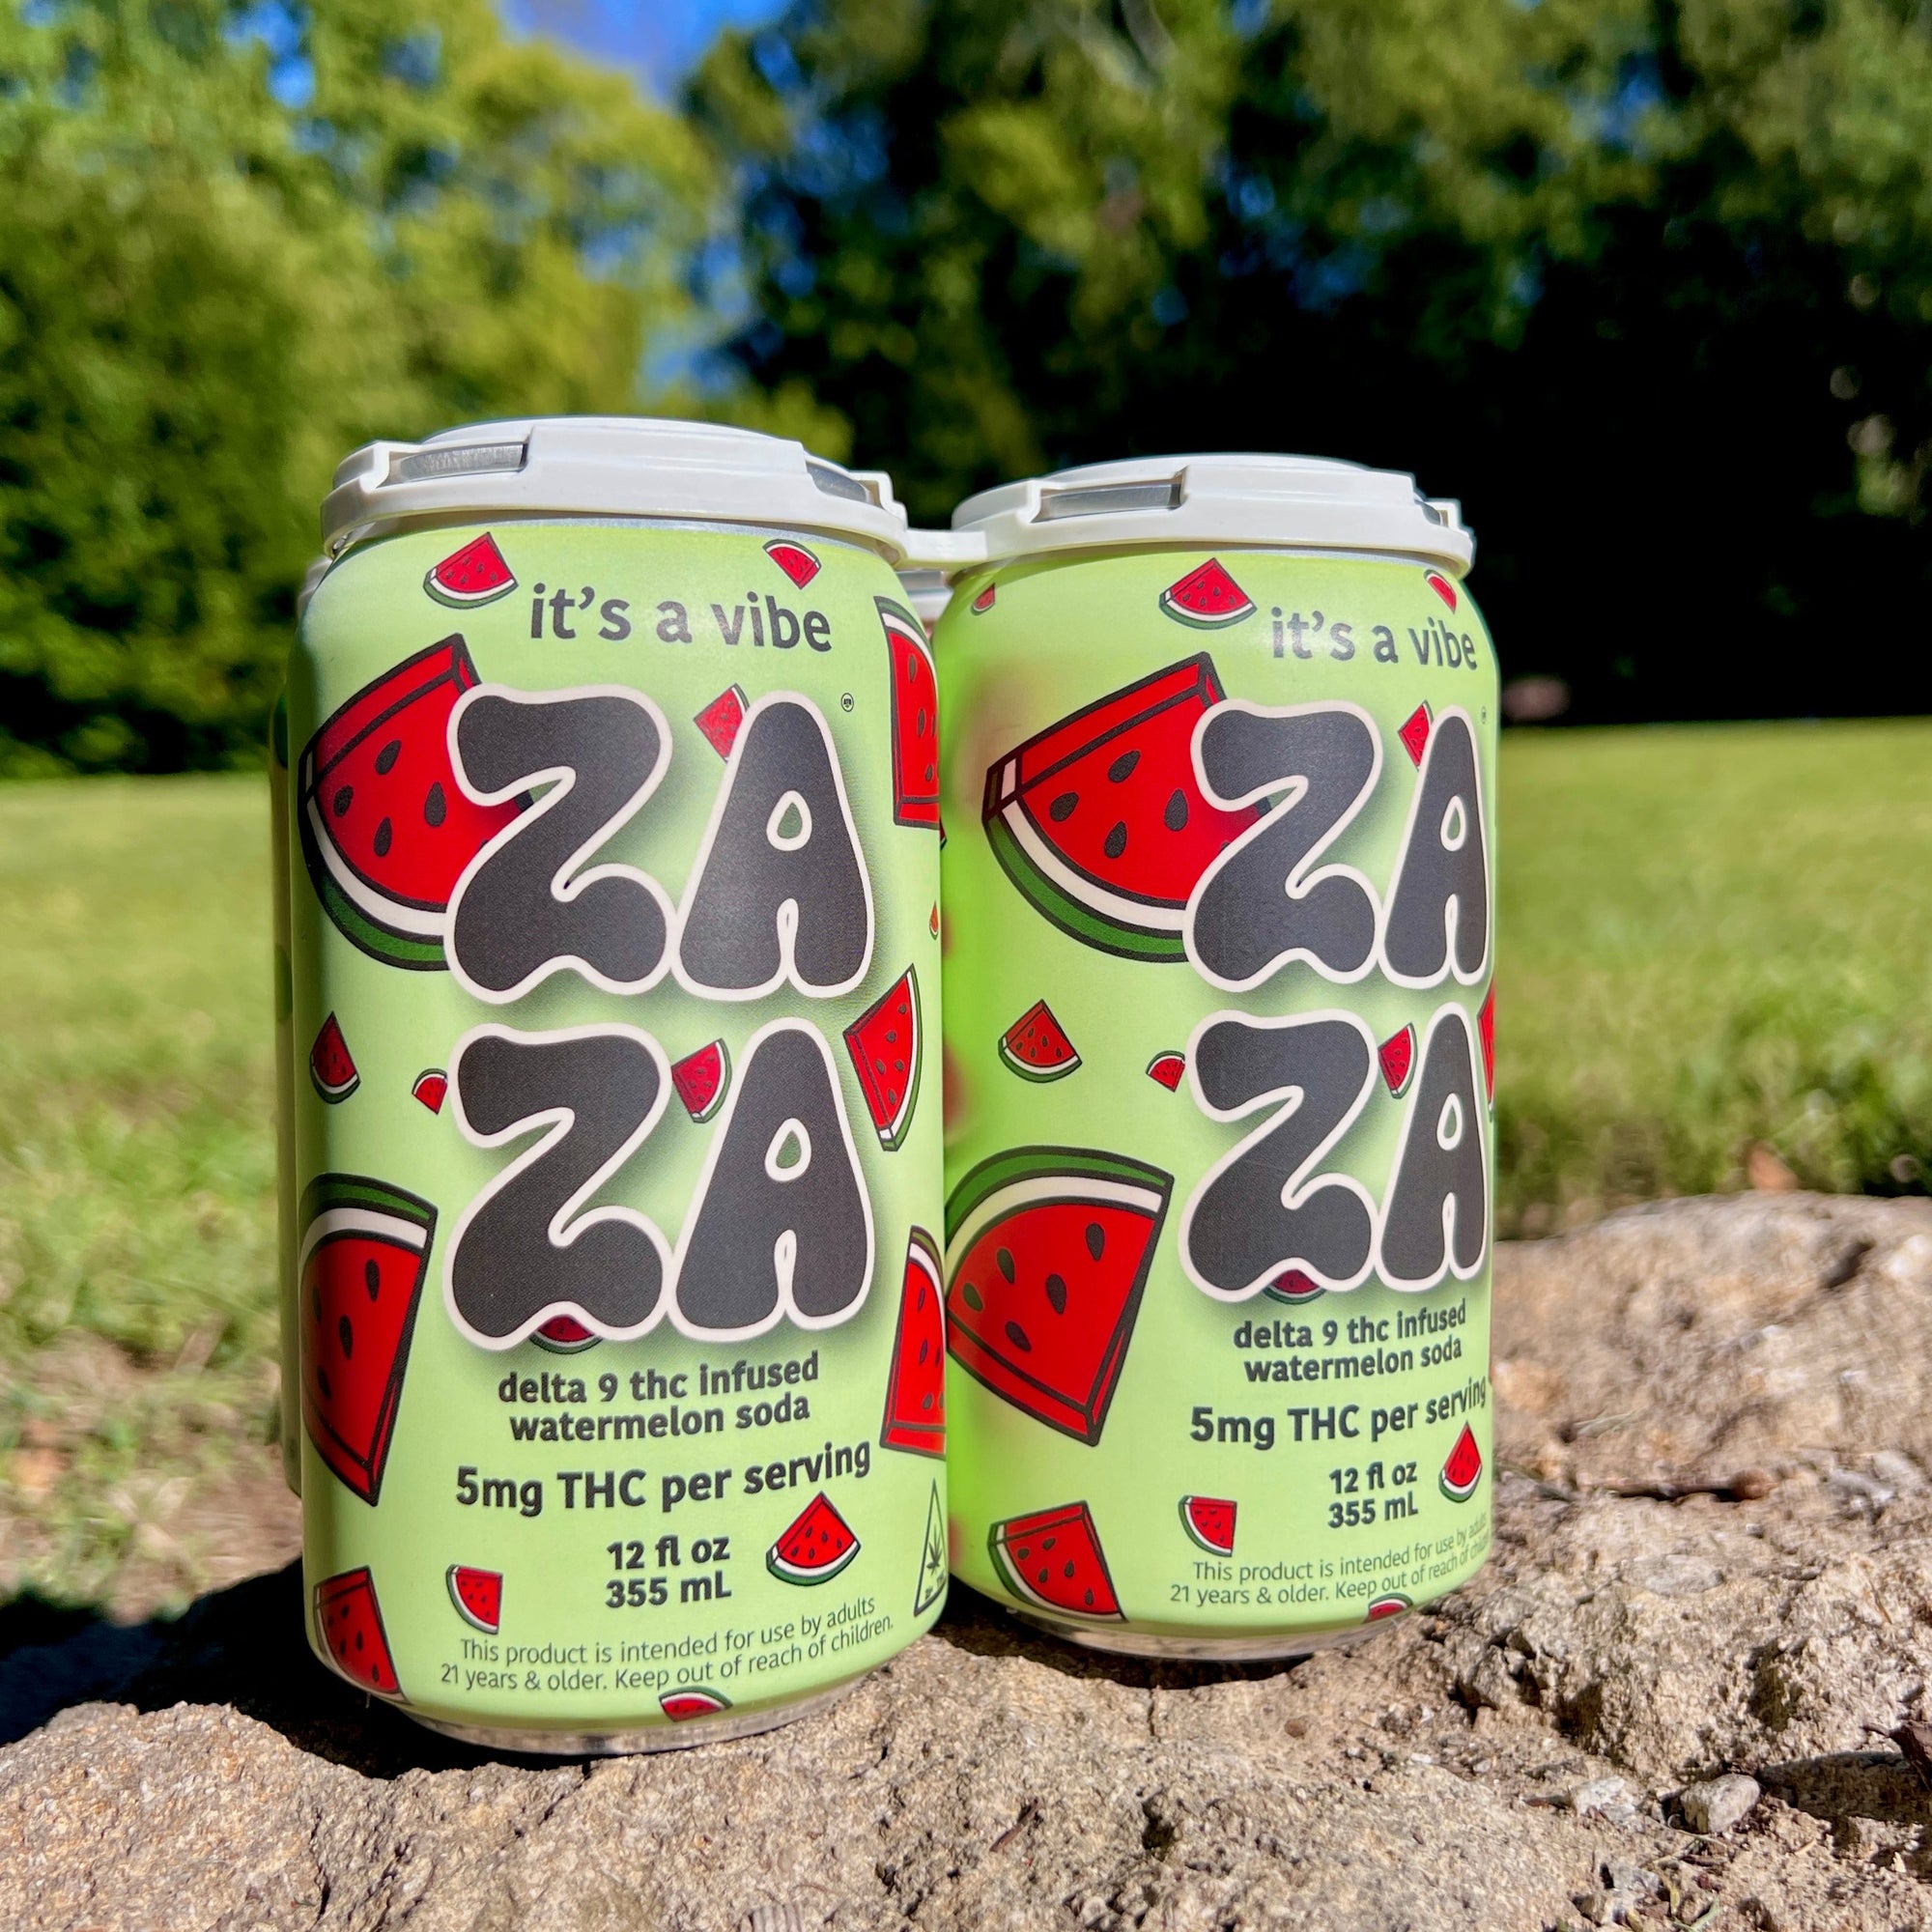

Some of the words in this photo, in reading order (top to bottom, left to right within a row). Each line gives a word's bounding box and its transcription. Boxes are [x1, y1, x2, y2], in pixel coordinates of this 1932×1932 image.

[531, 583, 631, 640] it's
[657, 602, 693, 643] a
[709, 591, 832, 652] vibe
[1271, 607, 1355, 661] it's
[1372, 625, 1399, 664] a
[1407, 616, 1477, 670] vibe
[443, 683, 874, 1005] ZA
[1182, 698, 1489, 992] ZA
[1178, 1002, 1488, 1302] ZA
[442, 1017, 874, 1350] ZA
[1234, 1321, 1313, 1349] delta
[1322, 1321, 1338, 1346] 9
[1348, 1315, 1389, 1344] thc
[1396, 1297, 1466, 1339] infused
[498, 1371, 586, 1404] delta
[599, 1373, 618, 1402] 9
[630, 1367, 687, 1400] thc
[699, 1350, 819, 1395] infused
[1243, 1348, 1413, 1382] watermelon
[1420, 1335, 1462, 1368] soda
[510, 1404, 724, 1441] watermelon
[735, 1393, 810, 1429] soda
[1190, 1406, 1275, 1450] 5mg
[1287, 1405, 1360, 1442] THC
[1371, 1402, 1418, 1442] per
[1425, 1377, 1486, 1425] serving
[456, 1465, 543, 1516] 5mg
[557, 1468, 646, 1509] THC
[662, 1469, 731, 1513] per
[743, 1440, 871, 1493] serving
[1329, 1467, 1358, 1494] 12
[1366, 1461, 1384, 1490] fl
[1392, 1462, 1417, 1486] oz
[1328, 1498, 1376, 1528] 355
[1384, 1491, 1418, 1520] mL
[607, 1541, 644, 1571] 12
[656, 1534, 681, 1567] fl
[692, 1536, 729, 1563] oz
[1194, 1561, 1232, 1580] This
[1239, 1562, 1313, 1585] product
[1321, 1559, 1333, 1577] is
[1340, 1546, 1409, 1576] intended
[606, 1577, 668, 1608] 355
[681, 1570, 732, 1603] mL
[1171, 1584, 1189, 1602] 21
[1197, 1588, 1249, 1607] years
[1257, 1587, 1271, 1604] &
[1278, 1584, 1328, 1604] older.
[1336, 1580, 1377, 1603] Keep
[1382, 1571, 1407, 1590] out
[440, 1664, 459, 1683] 21
[465, 1668, 518, 1690] years
[524, 1670, 541, 1690] &
[548, 1666, 607, 1690] older.
[615, 1667, 668, 1690] Keep
[676, 1662, 713, 1685] out
[721, 1656, 742, 1680] of
[748, 1644, 803, 1674] reach
[809, 1635, 827, 1660] of
[831, 1615, 894, 1652] children.
[460, 1638, 498, 1662] This
[506, 1641, 584, 1667] product
[595, 1639, 611, 1663] is
[620, 1634, 718, 1662] intended
[725, 1629, 754, 1651] for
[761, 1622, 794, 1643] use
[801, 1615, 822, 1639] by
[827, 1597, 875, 1629] adults
